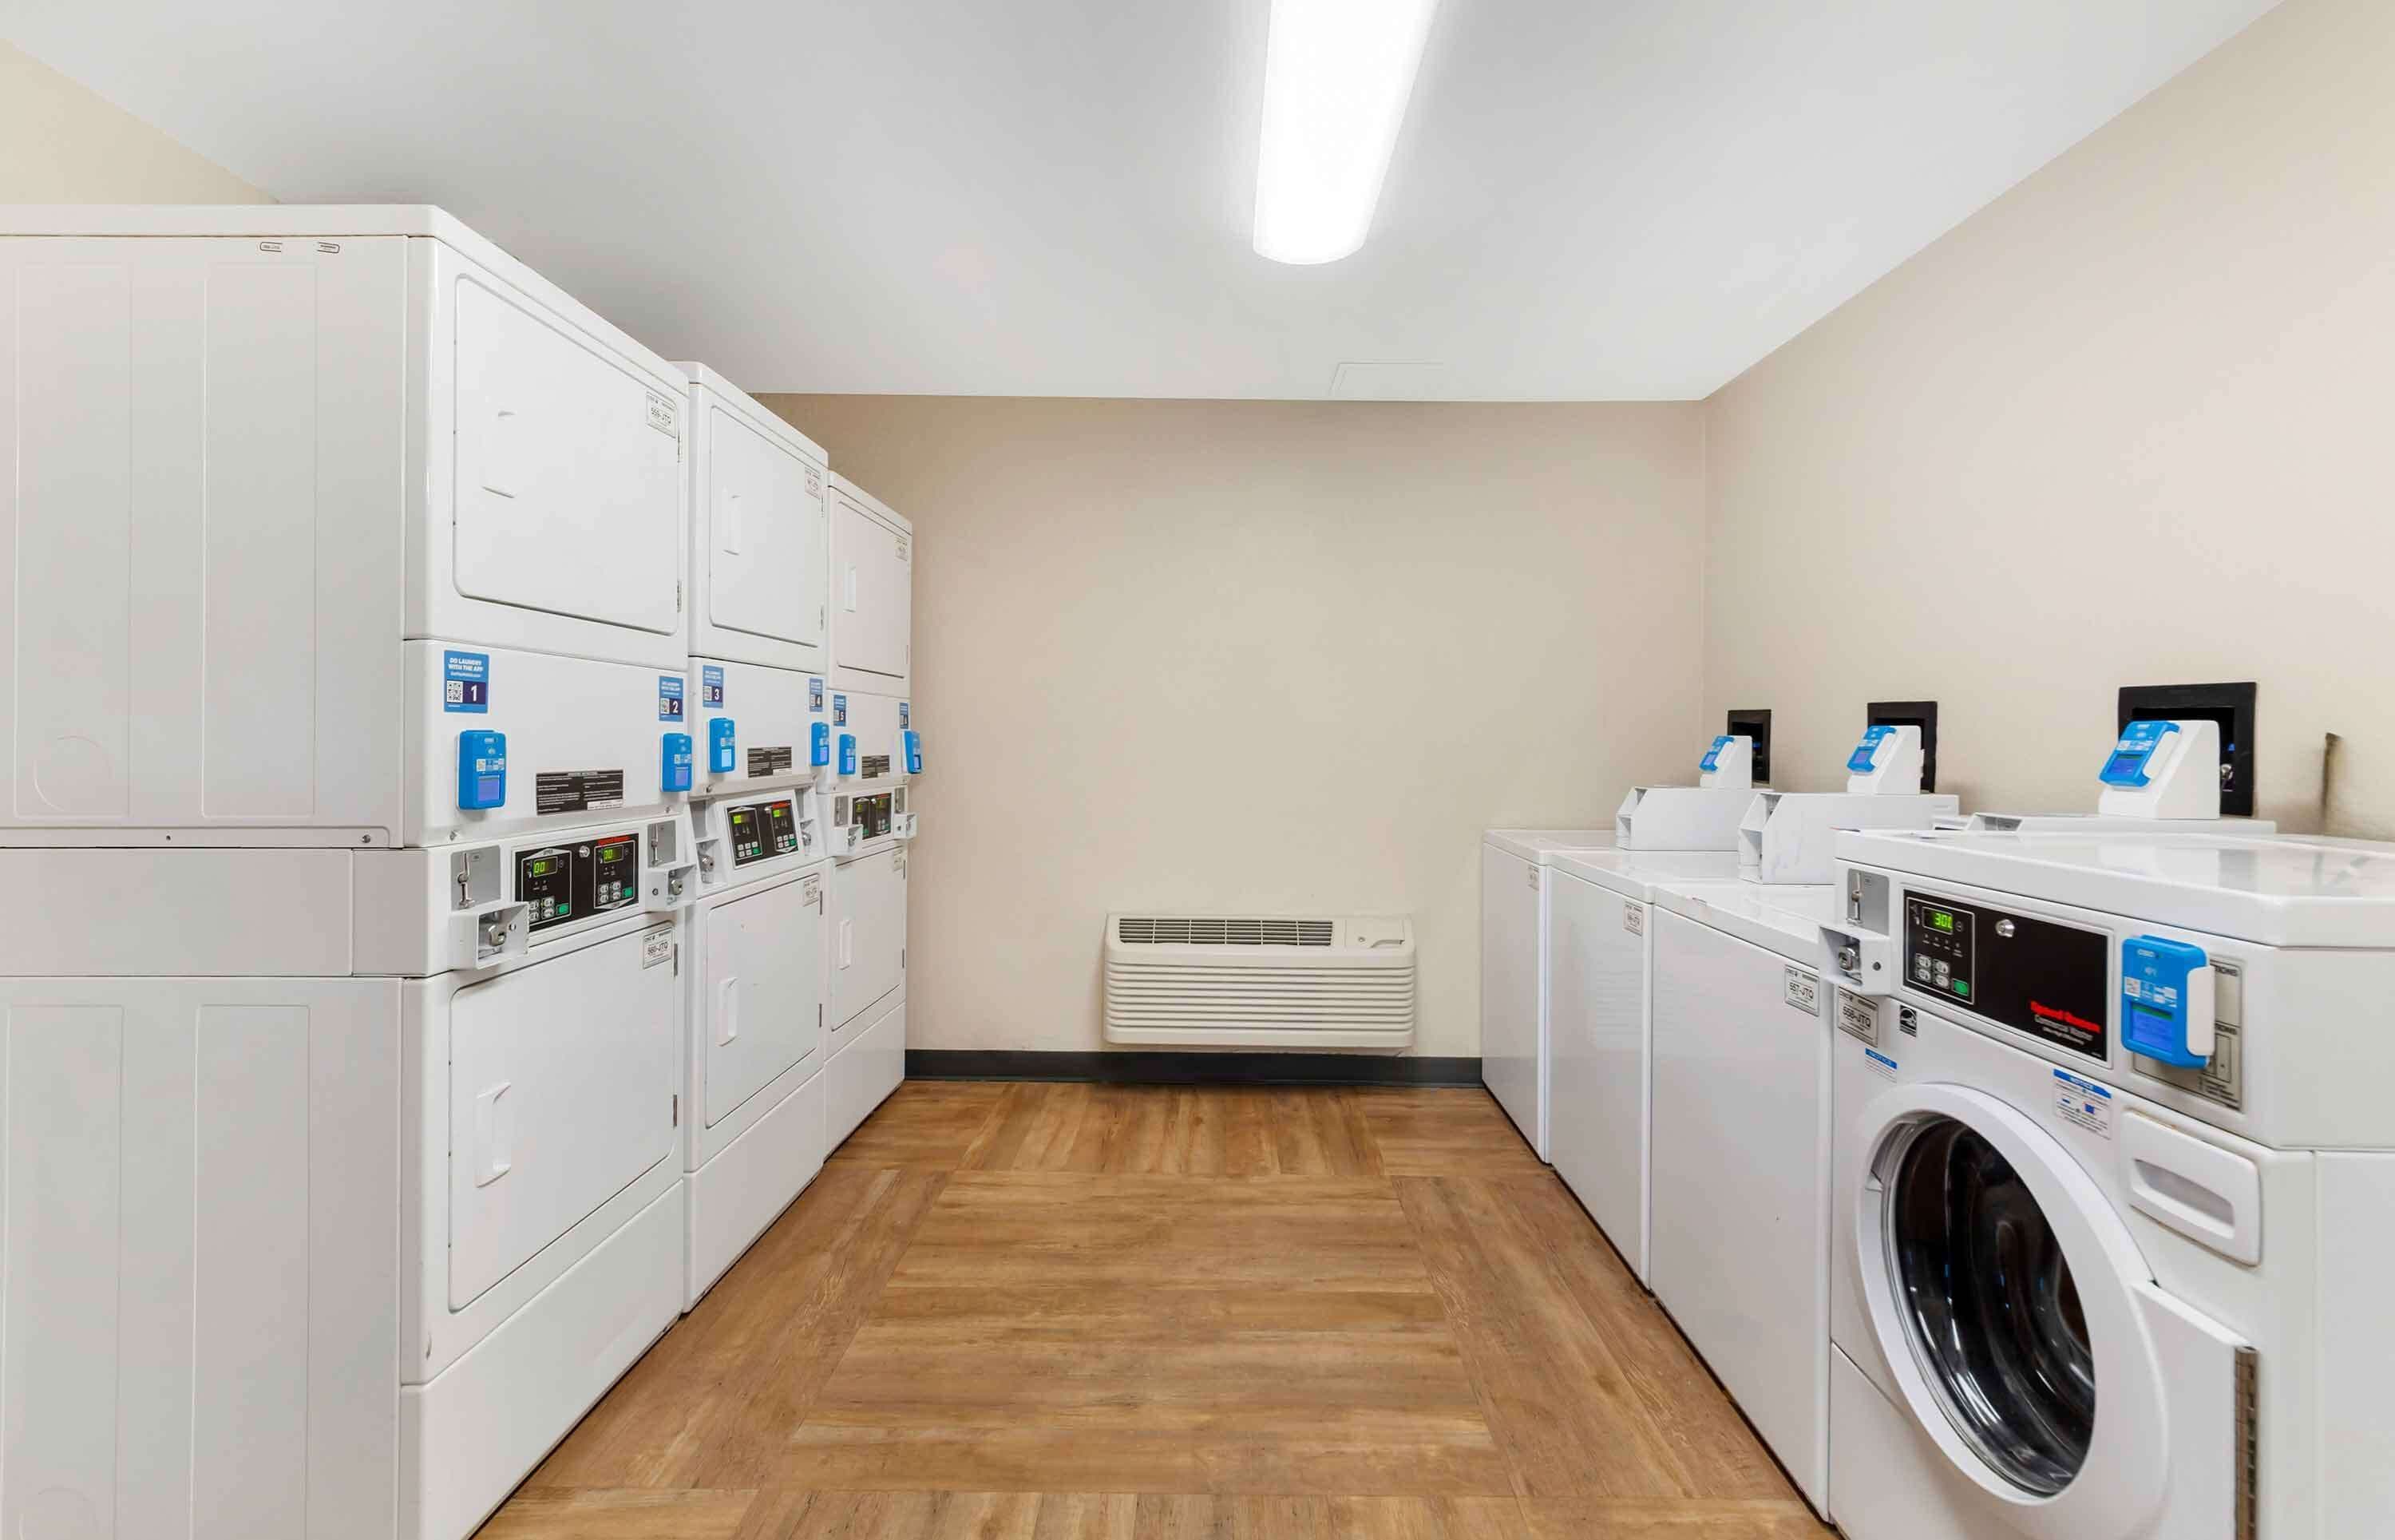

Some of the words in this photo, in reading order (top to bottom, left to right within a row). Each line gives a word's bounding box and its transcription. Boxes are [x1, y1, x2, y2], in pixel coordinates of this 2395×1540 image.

[470, 684, 477, 702] 1
[715, 688, 720, 701] 3
[672, 700, 679, 713] 2
